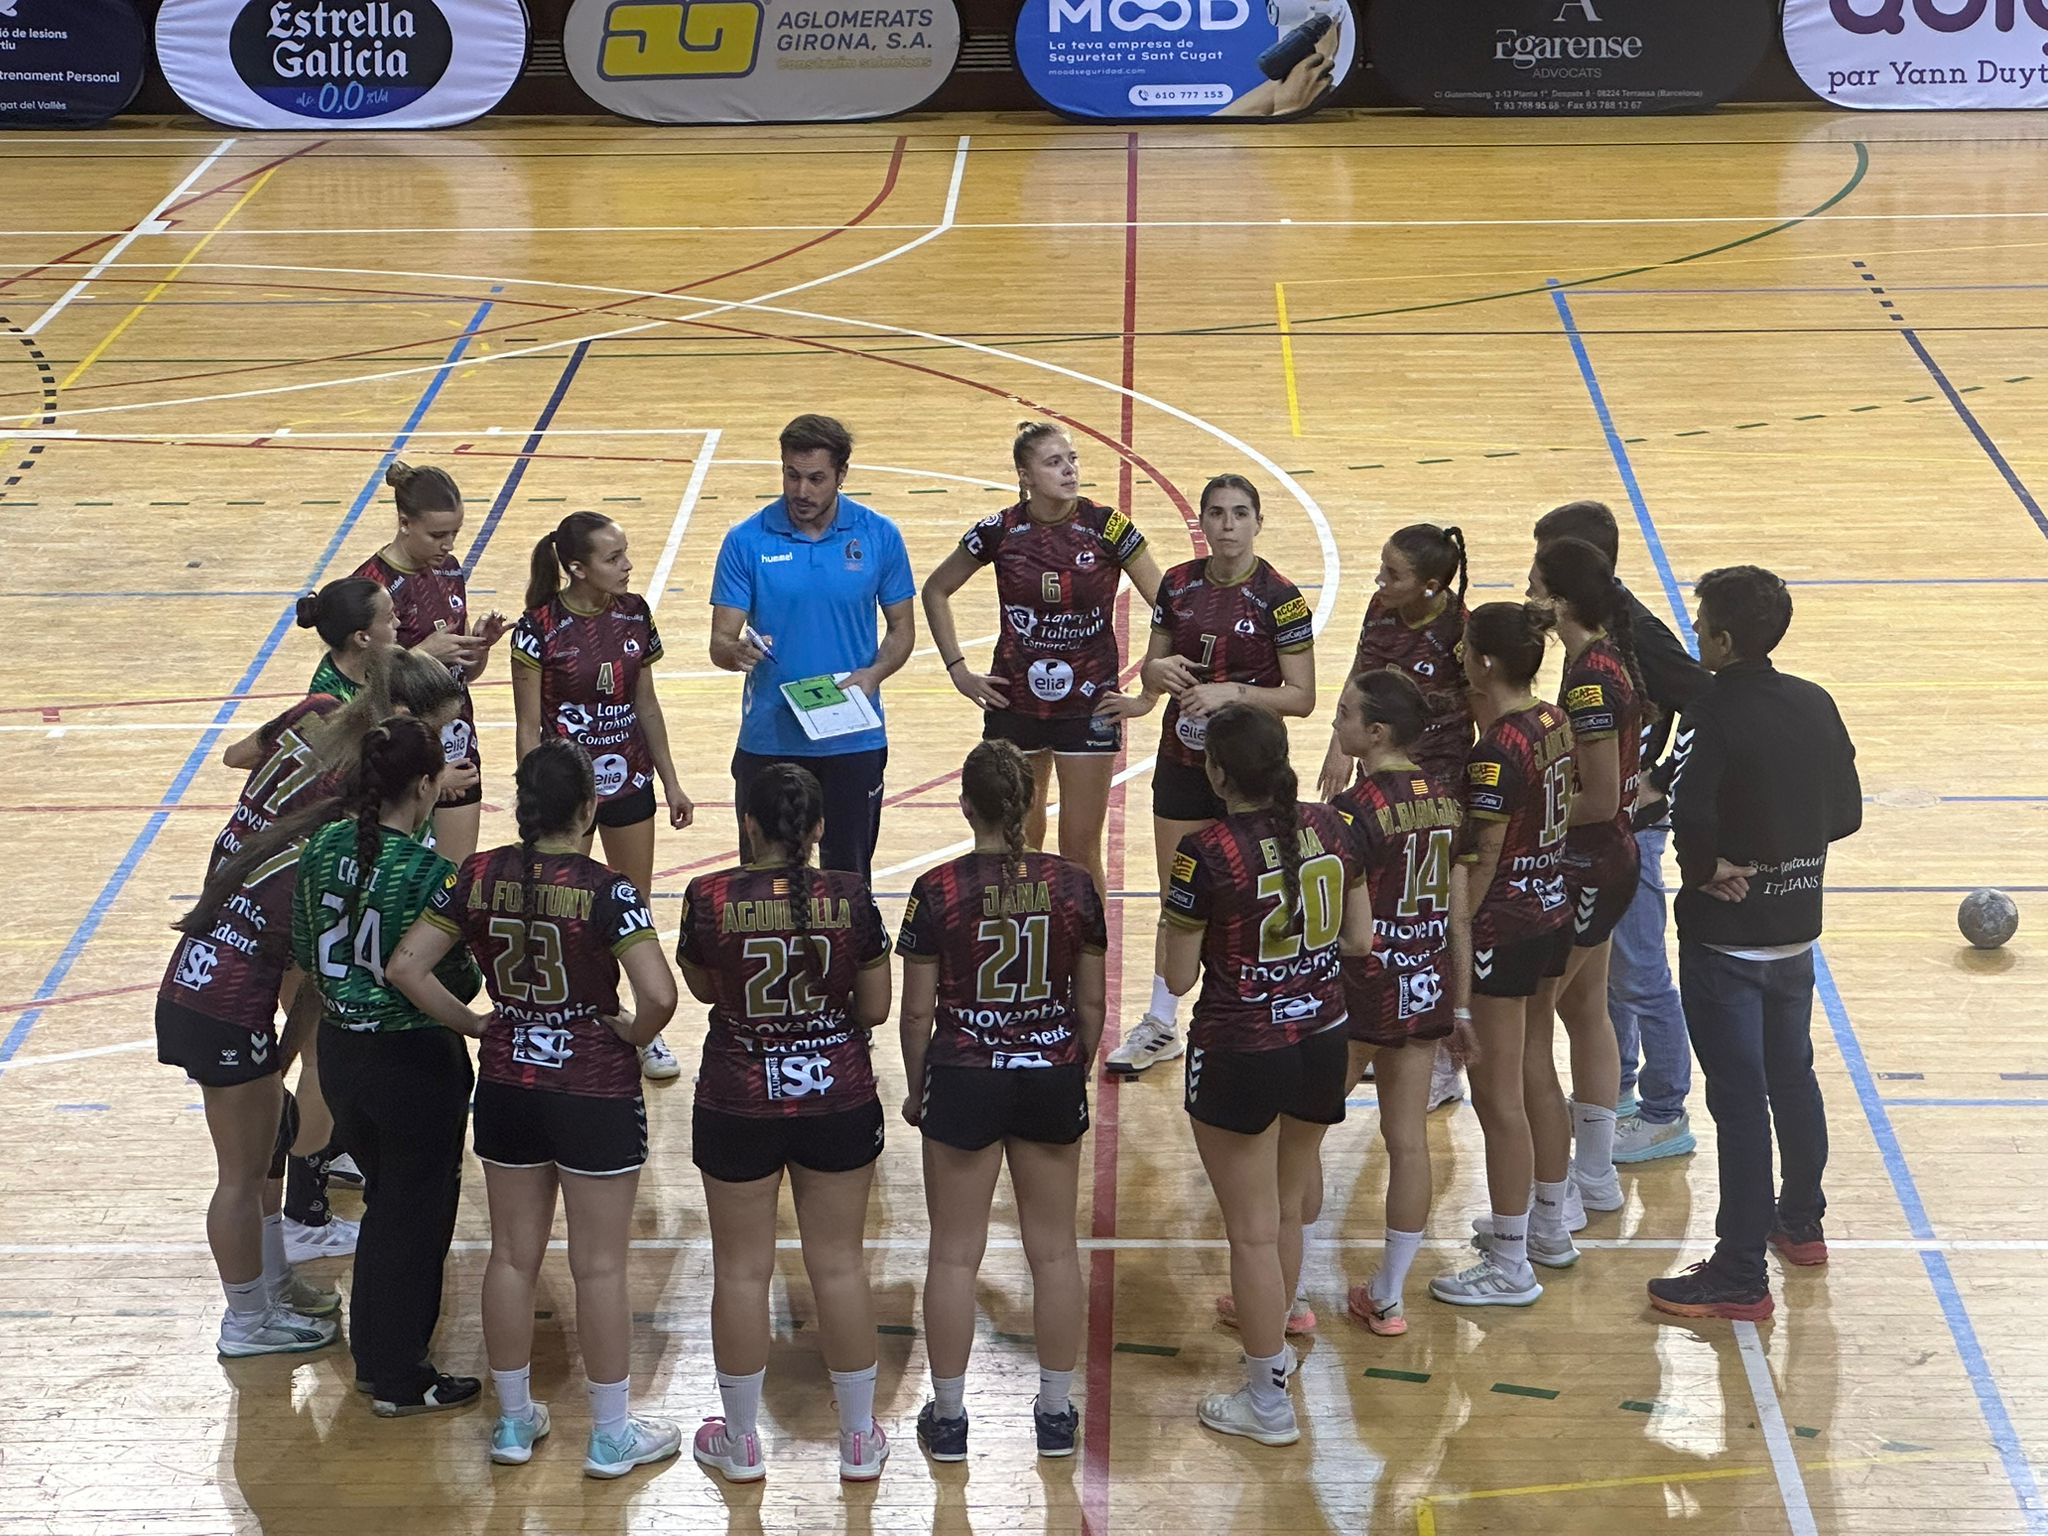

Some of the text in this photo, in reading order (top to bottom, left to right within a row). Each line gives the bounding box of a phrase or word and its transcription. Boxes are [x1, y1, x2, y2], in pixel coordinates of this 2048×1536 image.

[12, 28, 26, 39] de
[29, 28, 68, 39] lesions
[266, 1, 416, 38] Estrella
[777, 9, 933, 30] AGLOMERATS
[777, 32, 932, 51] GIRONA, S.A.
[1049, 39, 1194, 53] La teva empresa de
[1049, 53, 1122, 64] Seguretat
[1141, 51, 1175, 61] Sant
[1180, 51, 1224, 62] Cugat
[1493, 29, 1642, 69] Egarense
[273, 40, 408, 78] Galicia
[1532, 68, 1602, 78] ADVOCATS
[66, 71, 120, 83] Personal
[1828, 71, 1880, 94] par
[1889, 61, 1967, 85] Yann
[20, 101, 36, 110] del
[38, 101, 67, 110] Vallès
[318, 81, 364, 113] 0,0
[1155, 91, 1224, 99] 610 777 153
[1568, 101, 1584, 109] Fax
[1586, 101, 1597, 109] 93
[761, 552, 793, 563] hummel
[1042, 572, 1062, 602] 6
[1200, 634, 1217, 668] 7
[597, 662, 614, 694] 4
[1035, 677, 1066, 690] elia
[444, 737, 465, 754] elia
[1539, 756, 1570, 848] 13
[1397, 829, 1453, 917] 14
[492, 880, 596, 922] FOTUNY
[722, 898, 851, 935] AGUILLLA
[1257, 854, 1344, 964] 20
[618, 907, 655, 936] JV
[318, 891, 386, 987] 24
[489, 917, 570, 1005] 23
[976, 915, 1052, 1004] 21
[743, 935, 831, 1017] 22
[949, 1000, 1066, 1028] movantis
[770, 1056, 782, 1098] ALUMINIS
